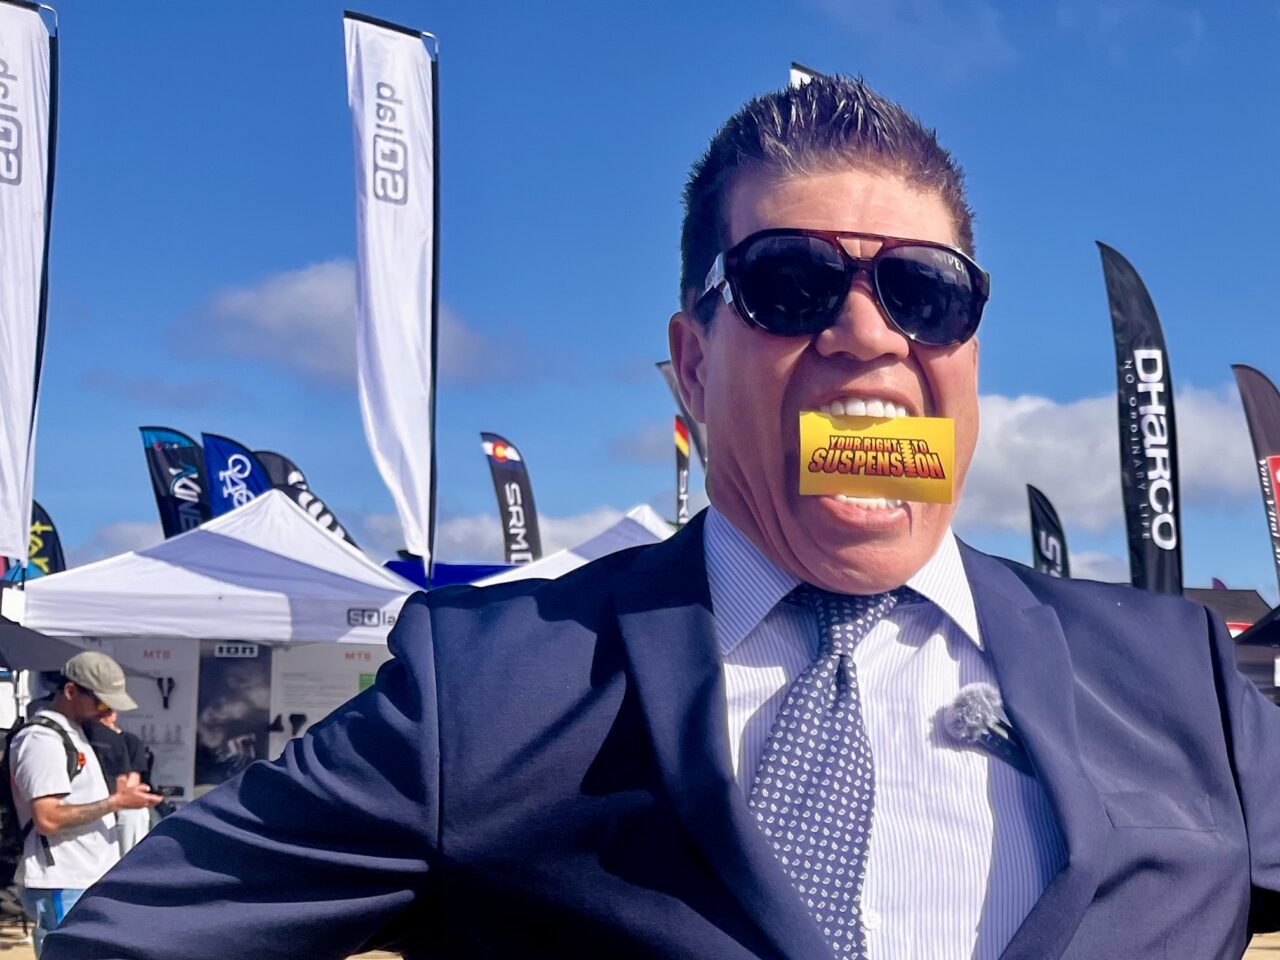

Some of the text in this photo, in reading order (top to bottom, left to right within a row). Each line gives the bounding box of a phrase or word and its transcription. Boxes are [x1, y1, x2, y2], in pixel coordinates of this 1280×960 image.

[829, 435, 929, 453] YOUR RIGHT TO
[1123, 360, 1135, 384] NO
[1139, 503, 1151, 540] LIFE
[1258, 458, 1271, 495] Your
[1266, 500, 1280, 538] Vital
[143, 650, 170, 660] MTB
[345, 651, 371, 661] MTB
